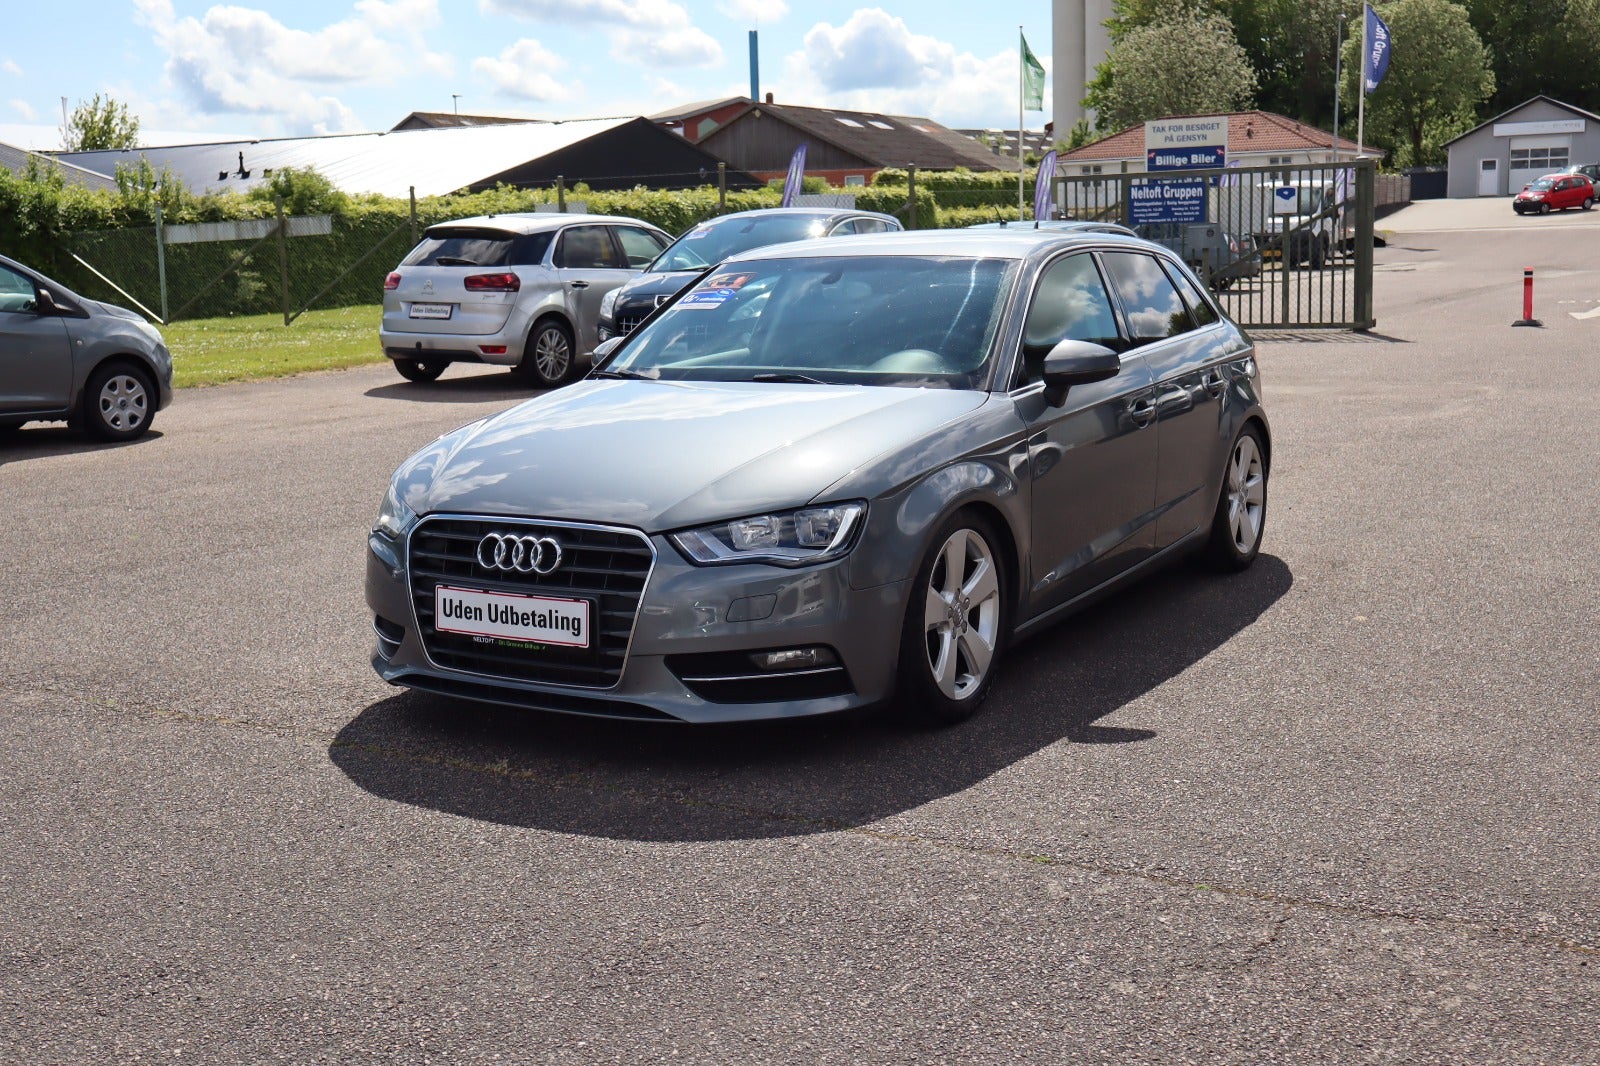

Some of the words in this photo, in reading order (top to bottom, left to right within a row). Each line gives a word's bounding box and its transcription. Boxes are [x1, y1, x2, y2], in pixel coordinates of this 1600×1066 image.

[1185, 123, 1220, 131] BESØGET
[1164, 135, 1174, 143] PÅ
[1176, 134, 1207, 142] GENSYN
[1156, 155, 1188, 166] Billige
[1191, 154, 1216, 164] Biler
[1131, 186, 1161, 199] Neltoft
[1163, 185, 1203, 200] Gruppen
[425, 307, 449, 315] Udbetaling
[442, 598, 482, 621] Uden
[487, 603, 581, 637] Udbetaling
